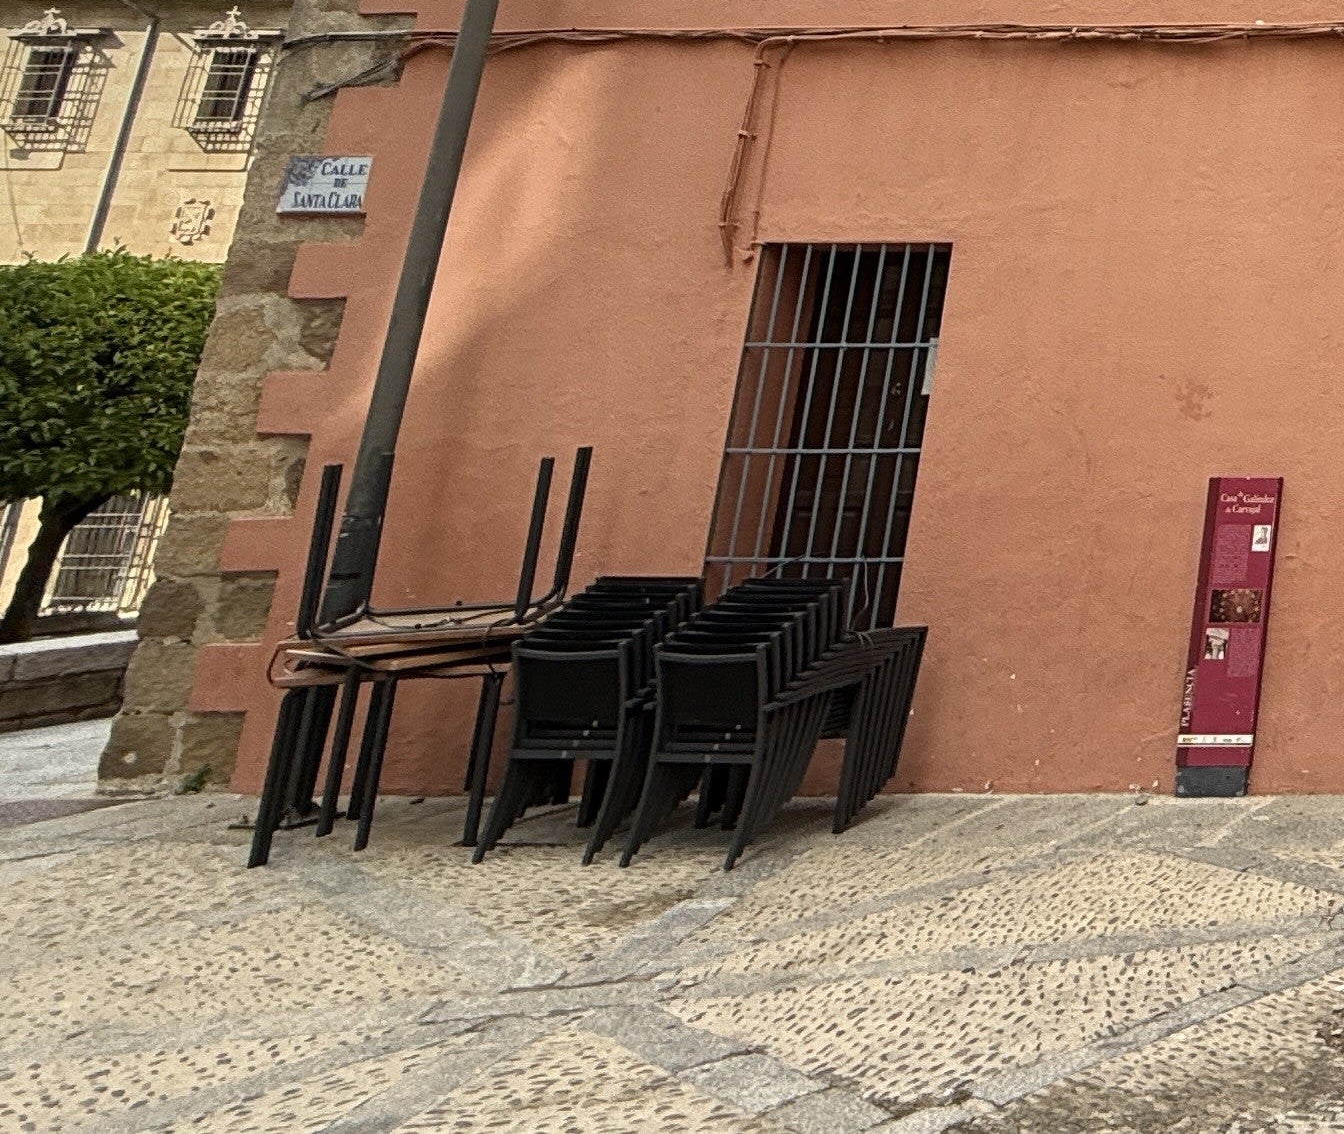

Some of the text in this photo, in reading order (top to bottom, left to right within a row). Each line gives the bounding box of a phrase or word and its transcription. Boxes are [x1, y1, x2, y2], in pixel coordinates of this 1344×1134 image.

[321, 162, 368, 176] CALLE
[334, 178, 348, 188] DE
[292, 191, 362, 208] SANTA CLARA
[1181, 669, 1196, 727] PLASENCIA
